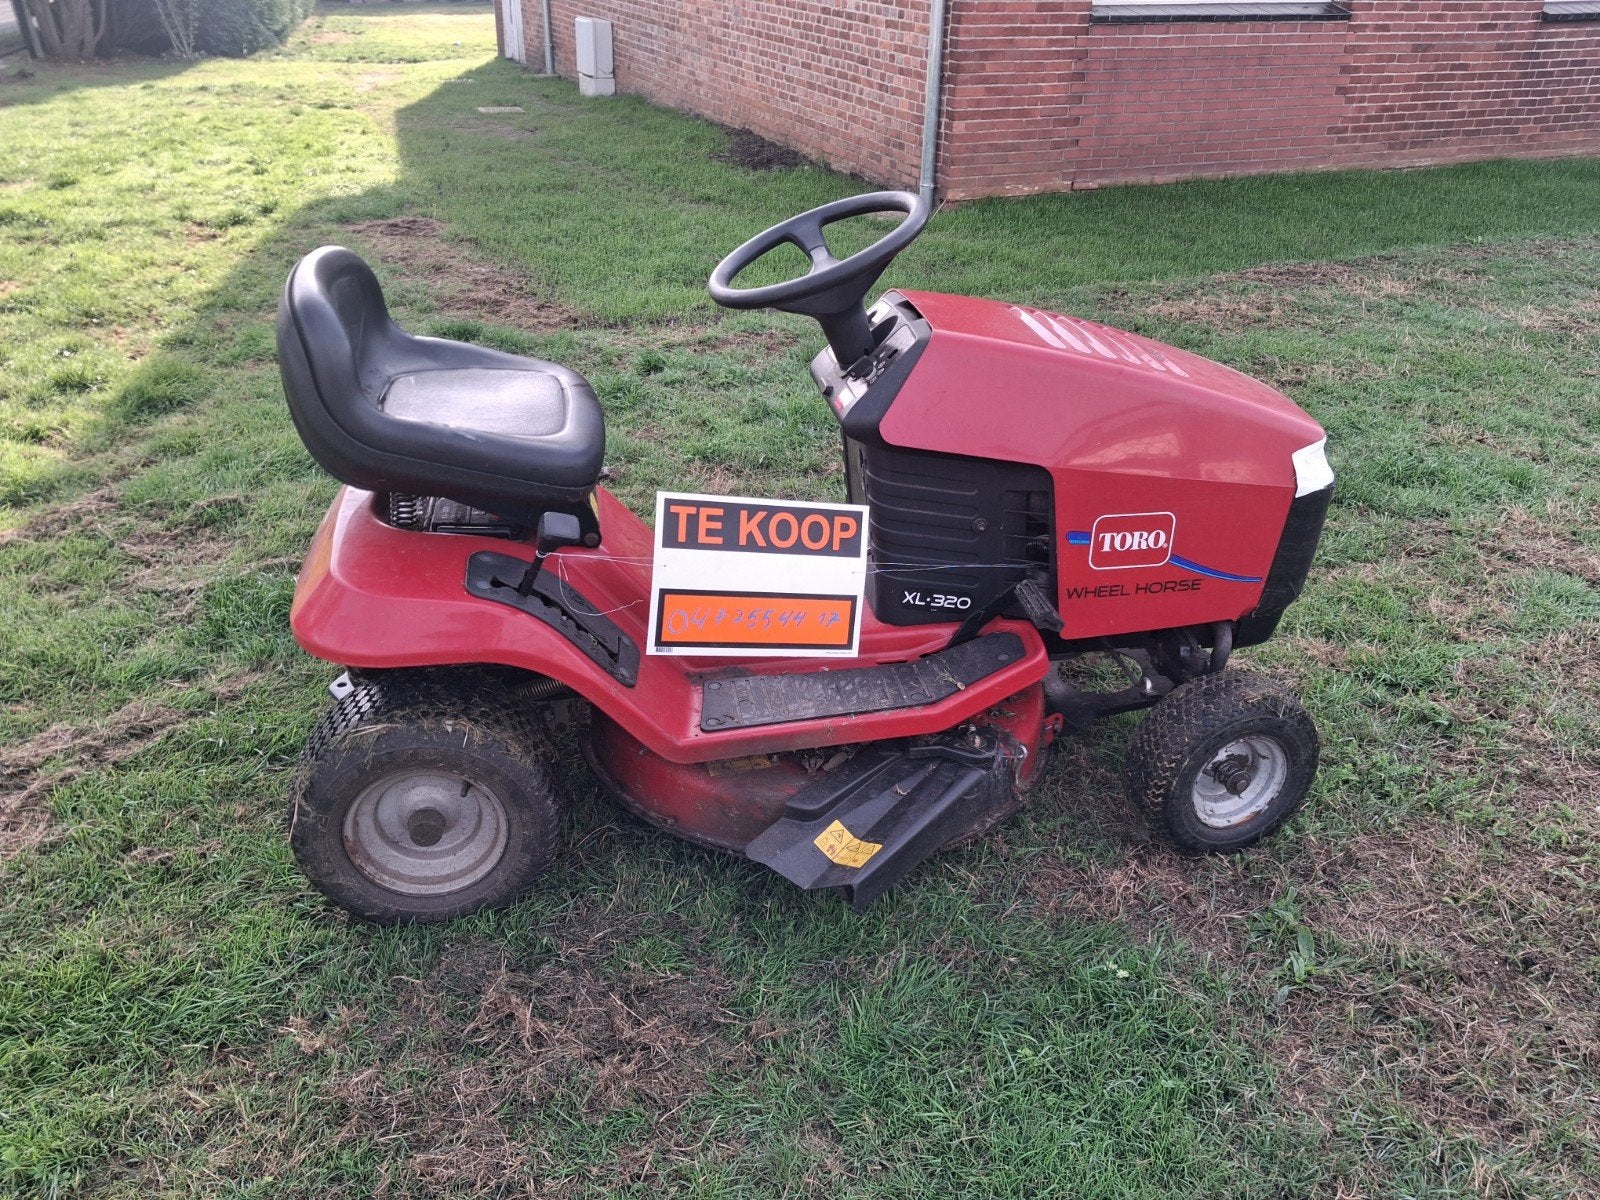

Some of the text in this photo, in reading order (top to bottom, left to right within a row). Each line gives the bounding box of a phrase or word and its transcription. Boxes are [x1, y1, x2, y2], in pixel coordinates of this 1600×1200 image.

[669, 505, 857, 551] TE KOOP
[1066, 578, 1205, 599] WHEEL HORSE
